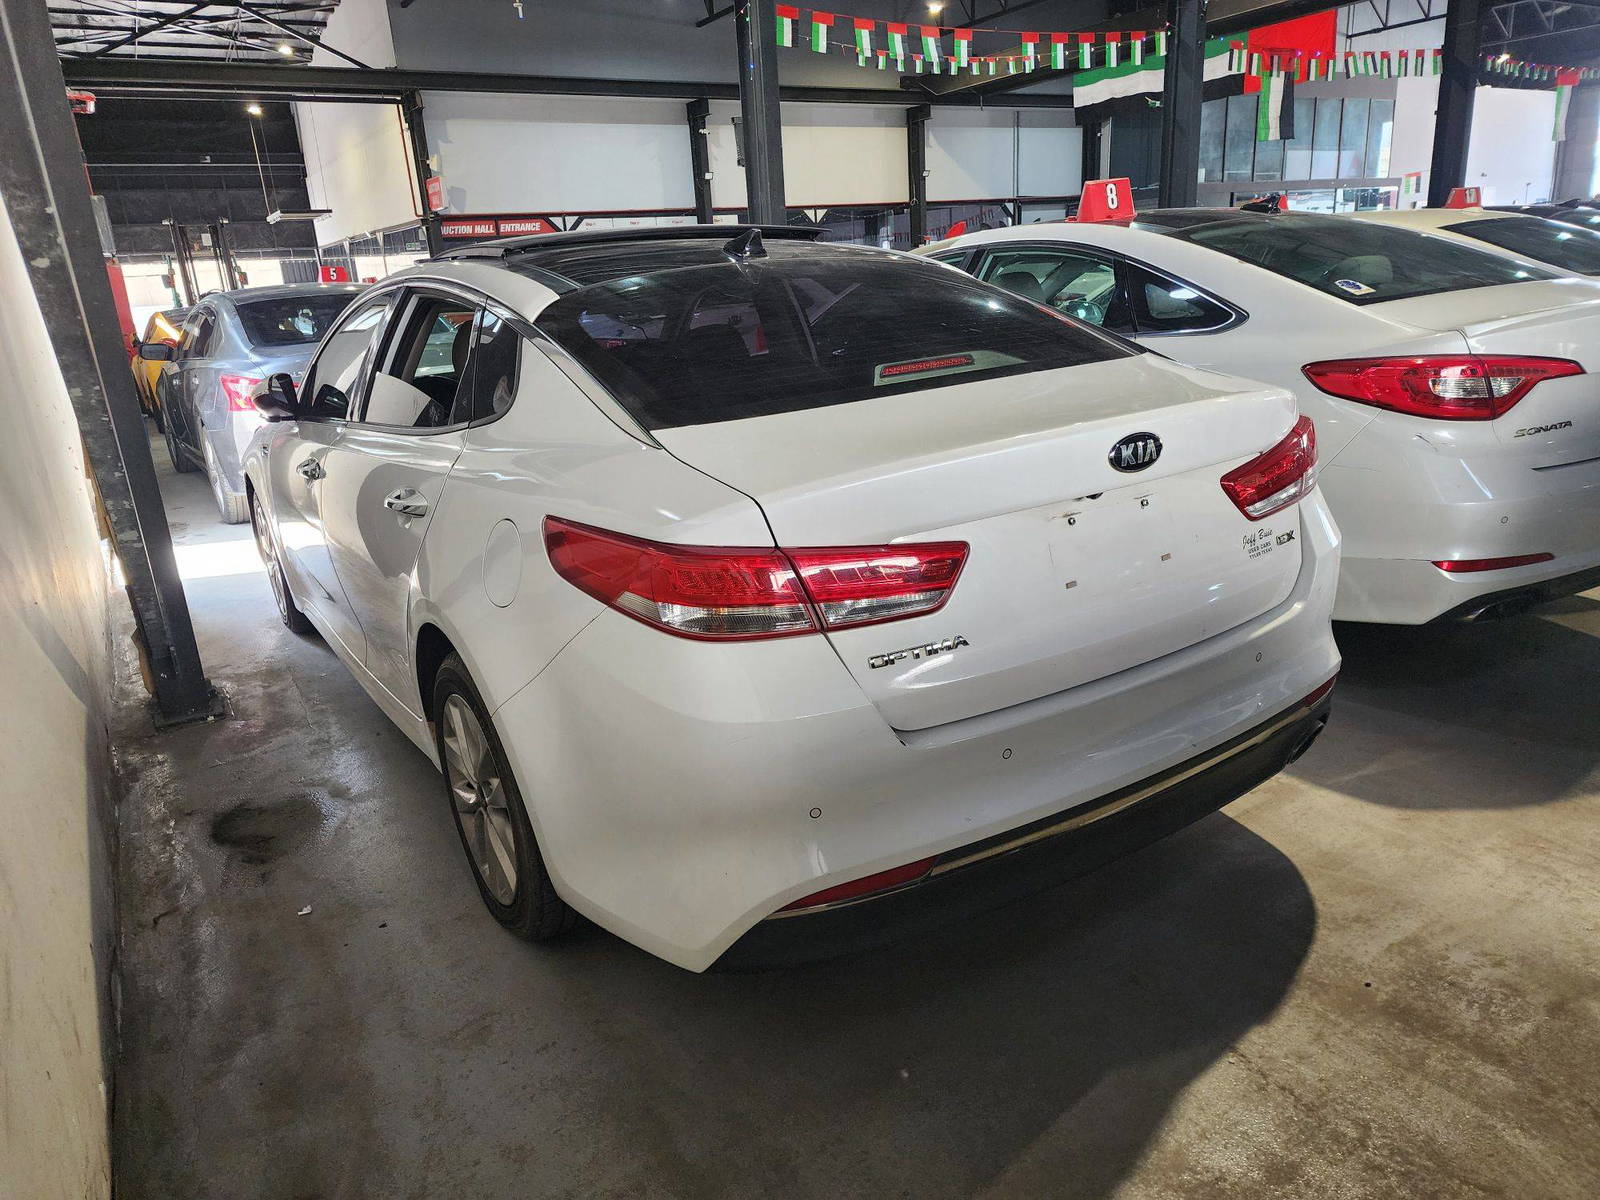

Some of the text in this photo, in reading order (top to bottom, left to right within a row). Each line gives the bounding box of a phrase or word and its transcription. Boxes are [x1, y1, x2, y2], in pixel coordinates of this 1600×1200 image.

[1106, 183, 1118, 210] 8
[474, 224, 495, 234] HALL
[500, 222, 541, 232] ENTRANCE
[329, 267, 337, 280] 5
[1514, 420, 1573, 438] SONATA
[1119, 439, 1158, 467] KIA
[867, 635, 970, 670] OPTIMA
